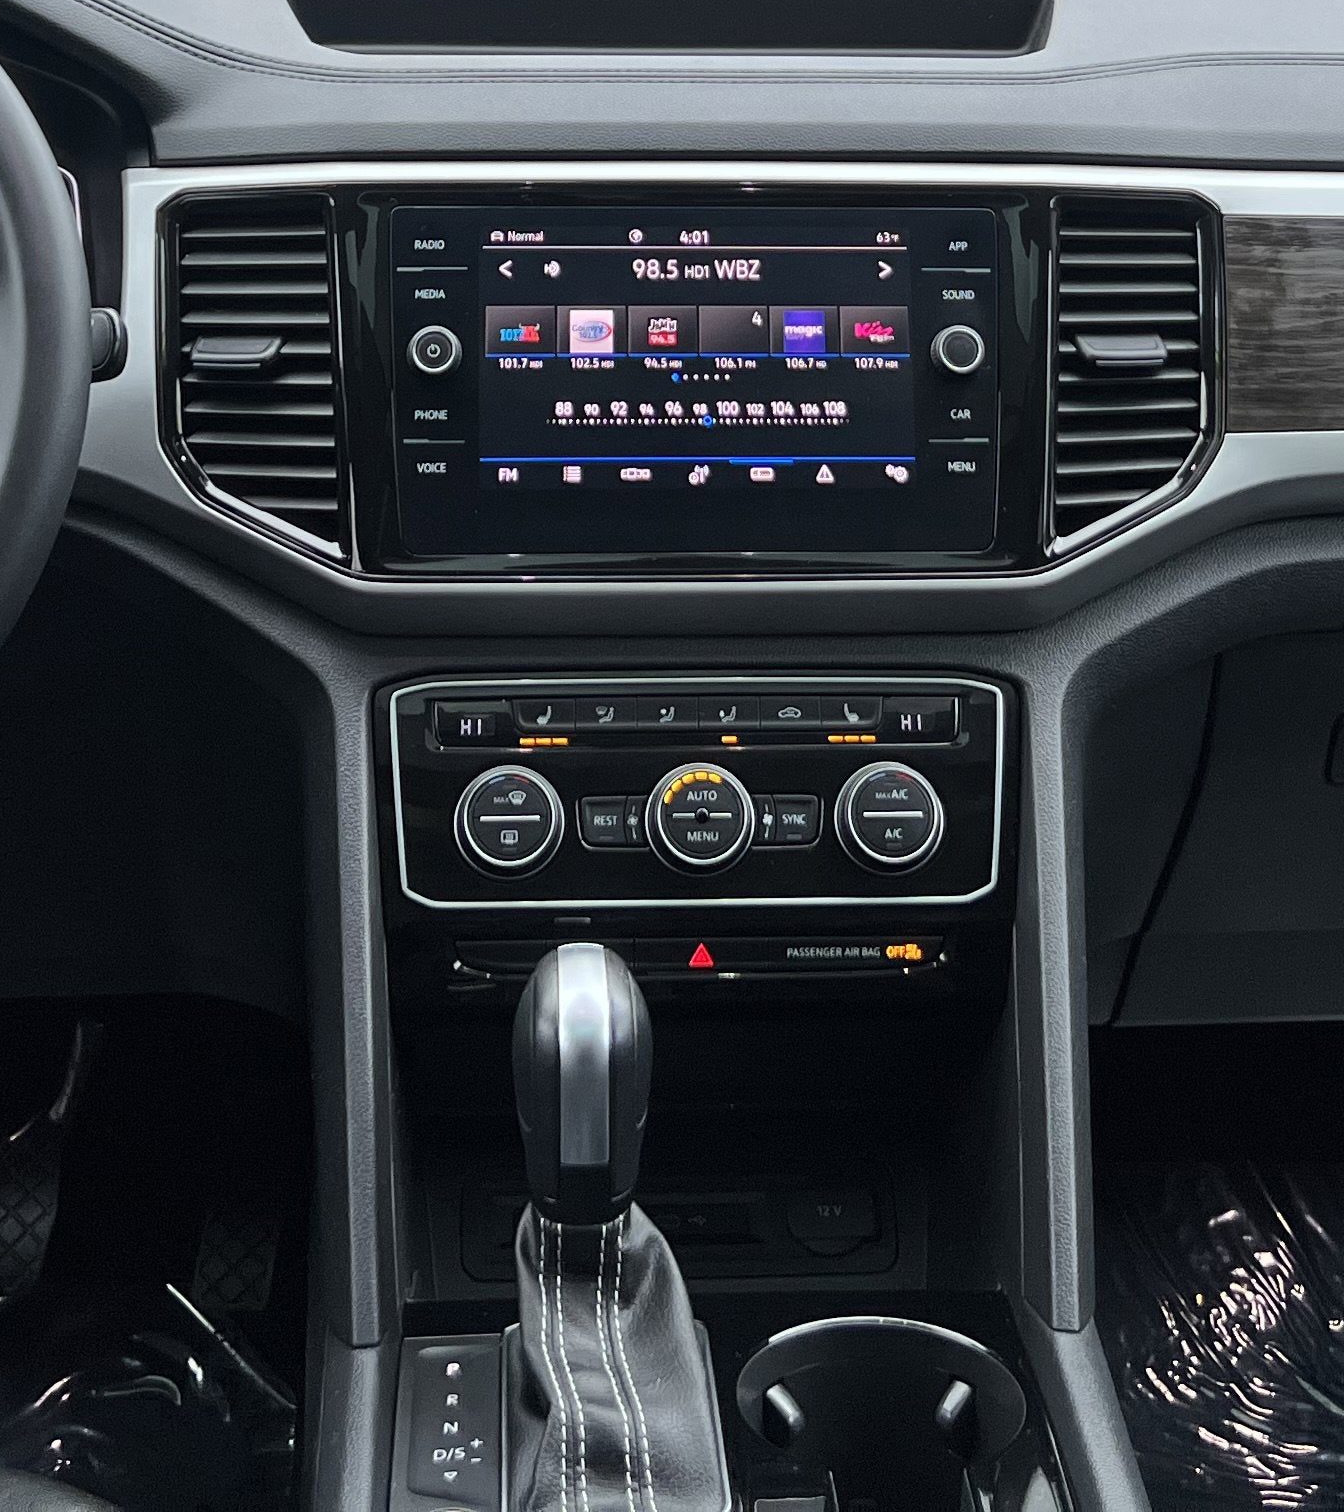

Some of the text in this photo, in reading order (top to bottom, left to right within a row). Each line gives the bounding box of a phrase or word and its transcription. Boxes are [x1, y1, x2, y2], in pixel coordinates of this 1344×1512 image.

[507, 230, 545, 242] Normal
[679, 230, 710, 244] 4:01
[414, 240, 445, 250] RADIO
[948, 241, 969, 252] APP
[632, 258, 761, 280] 98.5 HD1 WBZ
[415, 289, 446, 300] MEDIA
[942, 290, 975, 300] SOUND
[751, 311, 763, 327] 4
[784, 324, 823, 339] magic
[499, 357, 528, 369] 101.7
[570, 357, 600, 369] 102.5
[644, 357, 668, 369] 94.5
[714, 357, 743, 369] 106.1
[785, 357, 814, 369] 106.7
[854, 357, 884, 369] 107.9
[555, 401, 847, 417] 88 90 92 94 96 98 100 102 104 106 108
[950, 409, 971, 420] CAR
[414, 410, 448, 421] PHONE
[417, 462, 447, 473] VOICE
[948, 461, 976, 472] MENU
[498, 467, 519, 482] FM
[460, 718, 482, 736] HI
[900, 714, 922, 731] HI
[686, 790, 718, 801] AUTO
[891, 788, 908, 800] A/C
[593, 815, 618, 826] REST
[782, 813, 806, 825] SYNC
[687, 831, 719, 841] MENU
[884, 827, 903, 839] A/C
[786, 945, 905, 958] PASSENGER AIR BAG OFF
[446, 1362, 460, 1376] P
[446, 1393, 459, 1406] R
[443, 1421, 459, 1435] N
[433, 1447, 465, 1463] D/S
